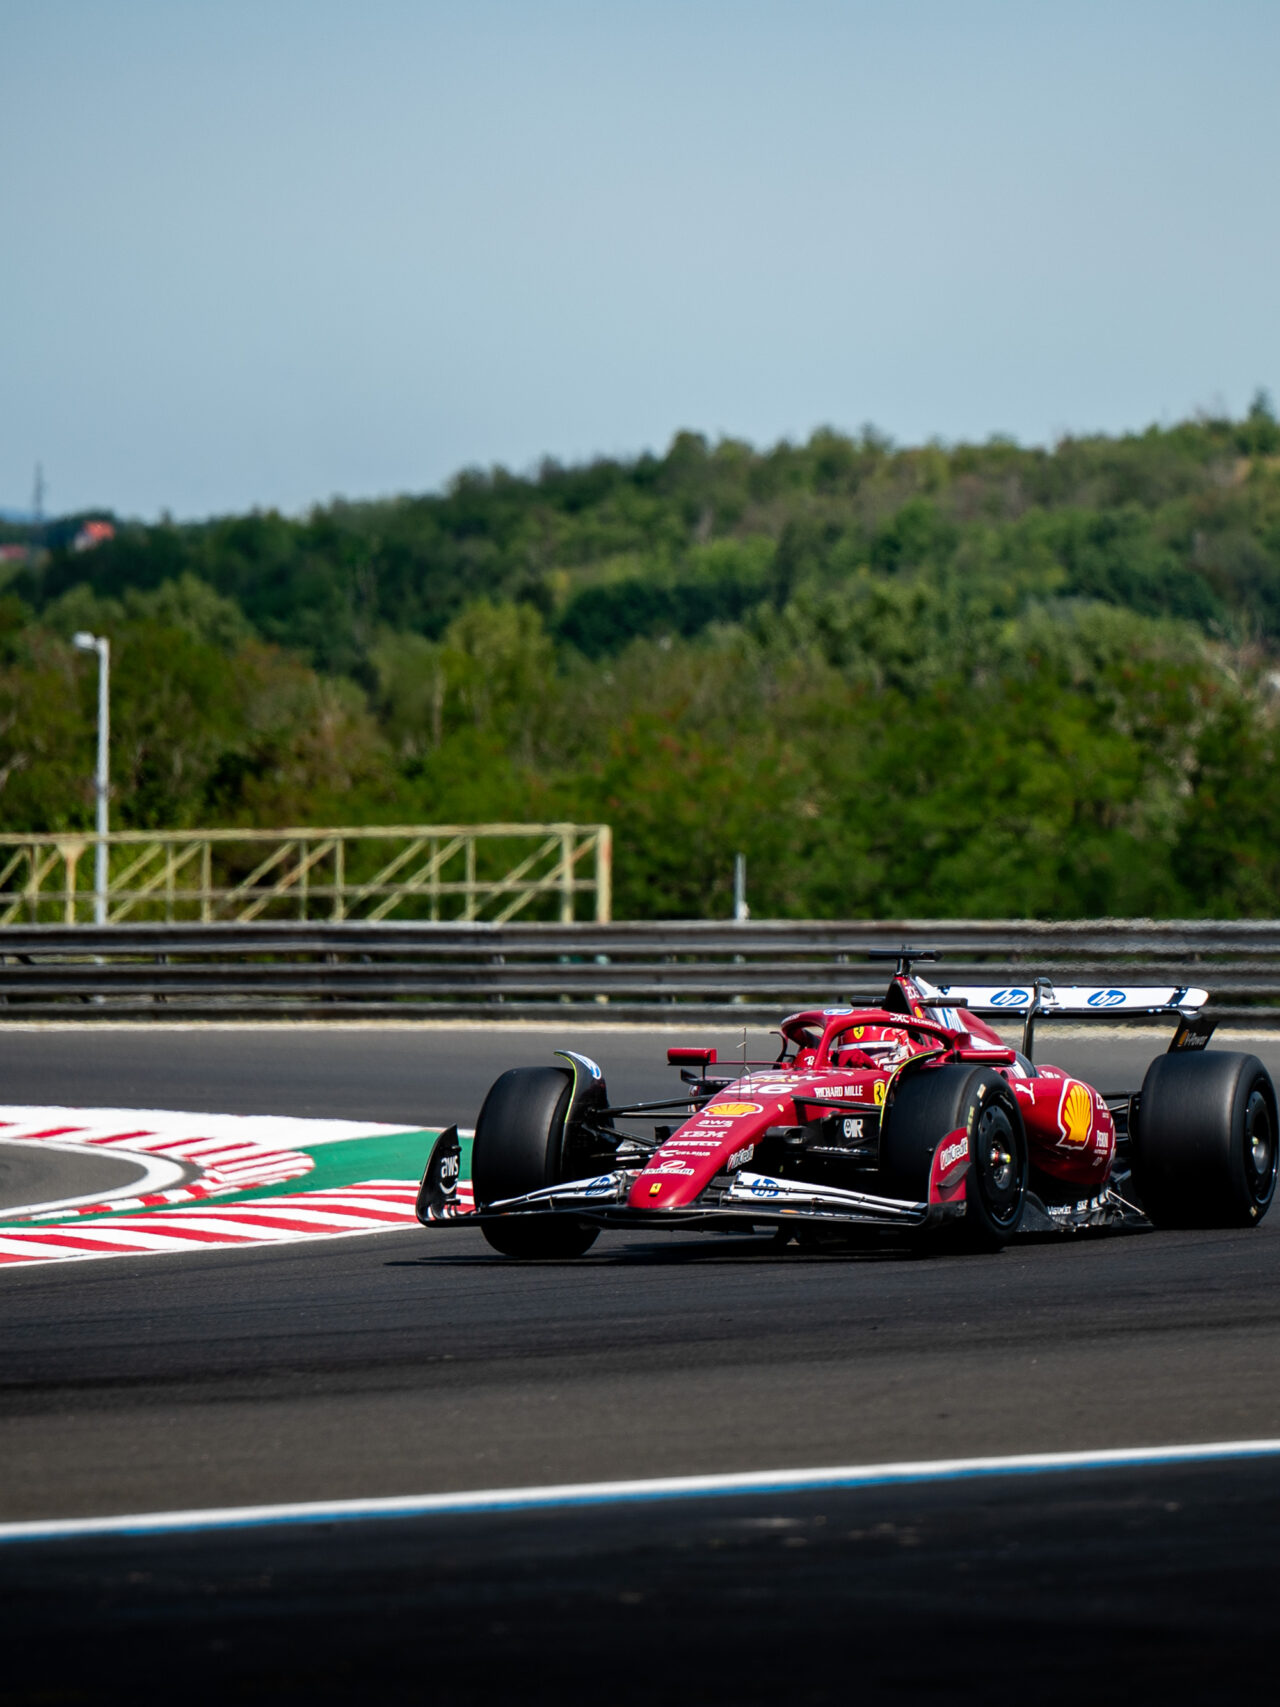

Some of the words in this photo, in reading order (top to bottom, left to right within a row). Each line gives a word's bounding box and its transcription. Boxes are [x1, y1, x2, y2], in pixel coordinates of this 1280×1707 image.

[993, 989, 1028, 1006] hp
[1091, 990, 1126, 1006] hp
[814, 1086, 843, 1098] RICHARD
[844, 1085, 863, 1096] MILLE
[680, 1130, 728, 1138] IBM
[441, 1155, 459, 1178] aws
